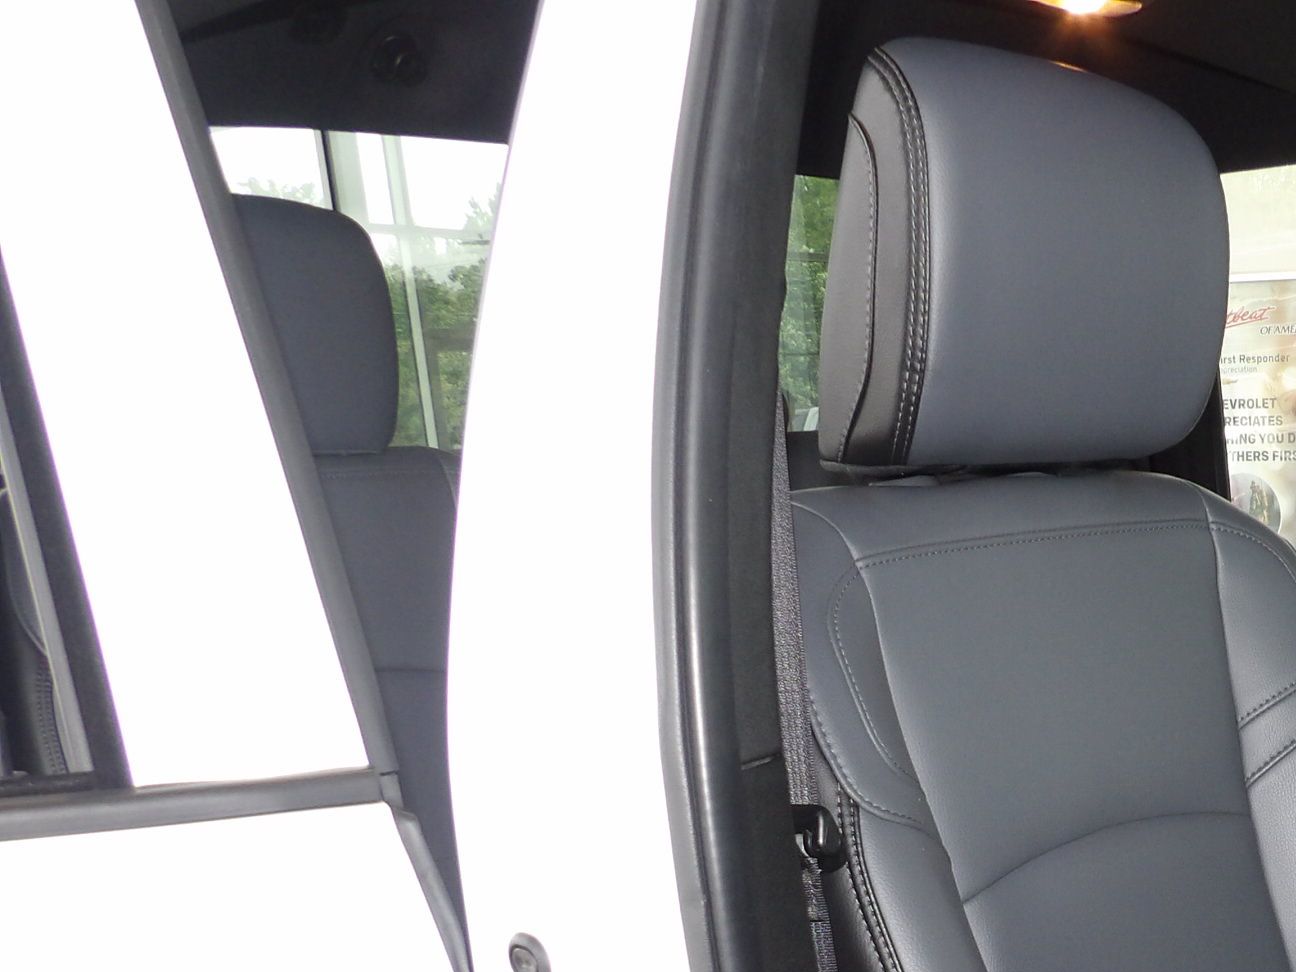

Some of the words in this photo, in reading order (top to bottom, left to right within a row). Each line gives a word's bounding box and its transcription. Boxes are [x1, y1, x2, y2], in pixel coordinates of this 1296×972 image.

[1260, 326, 1273, 335] OF
[1239, 353, 1290, 364] Responder
[1259, 432, 1285, 444] YOU
